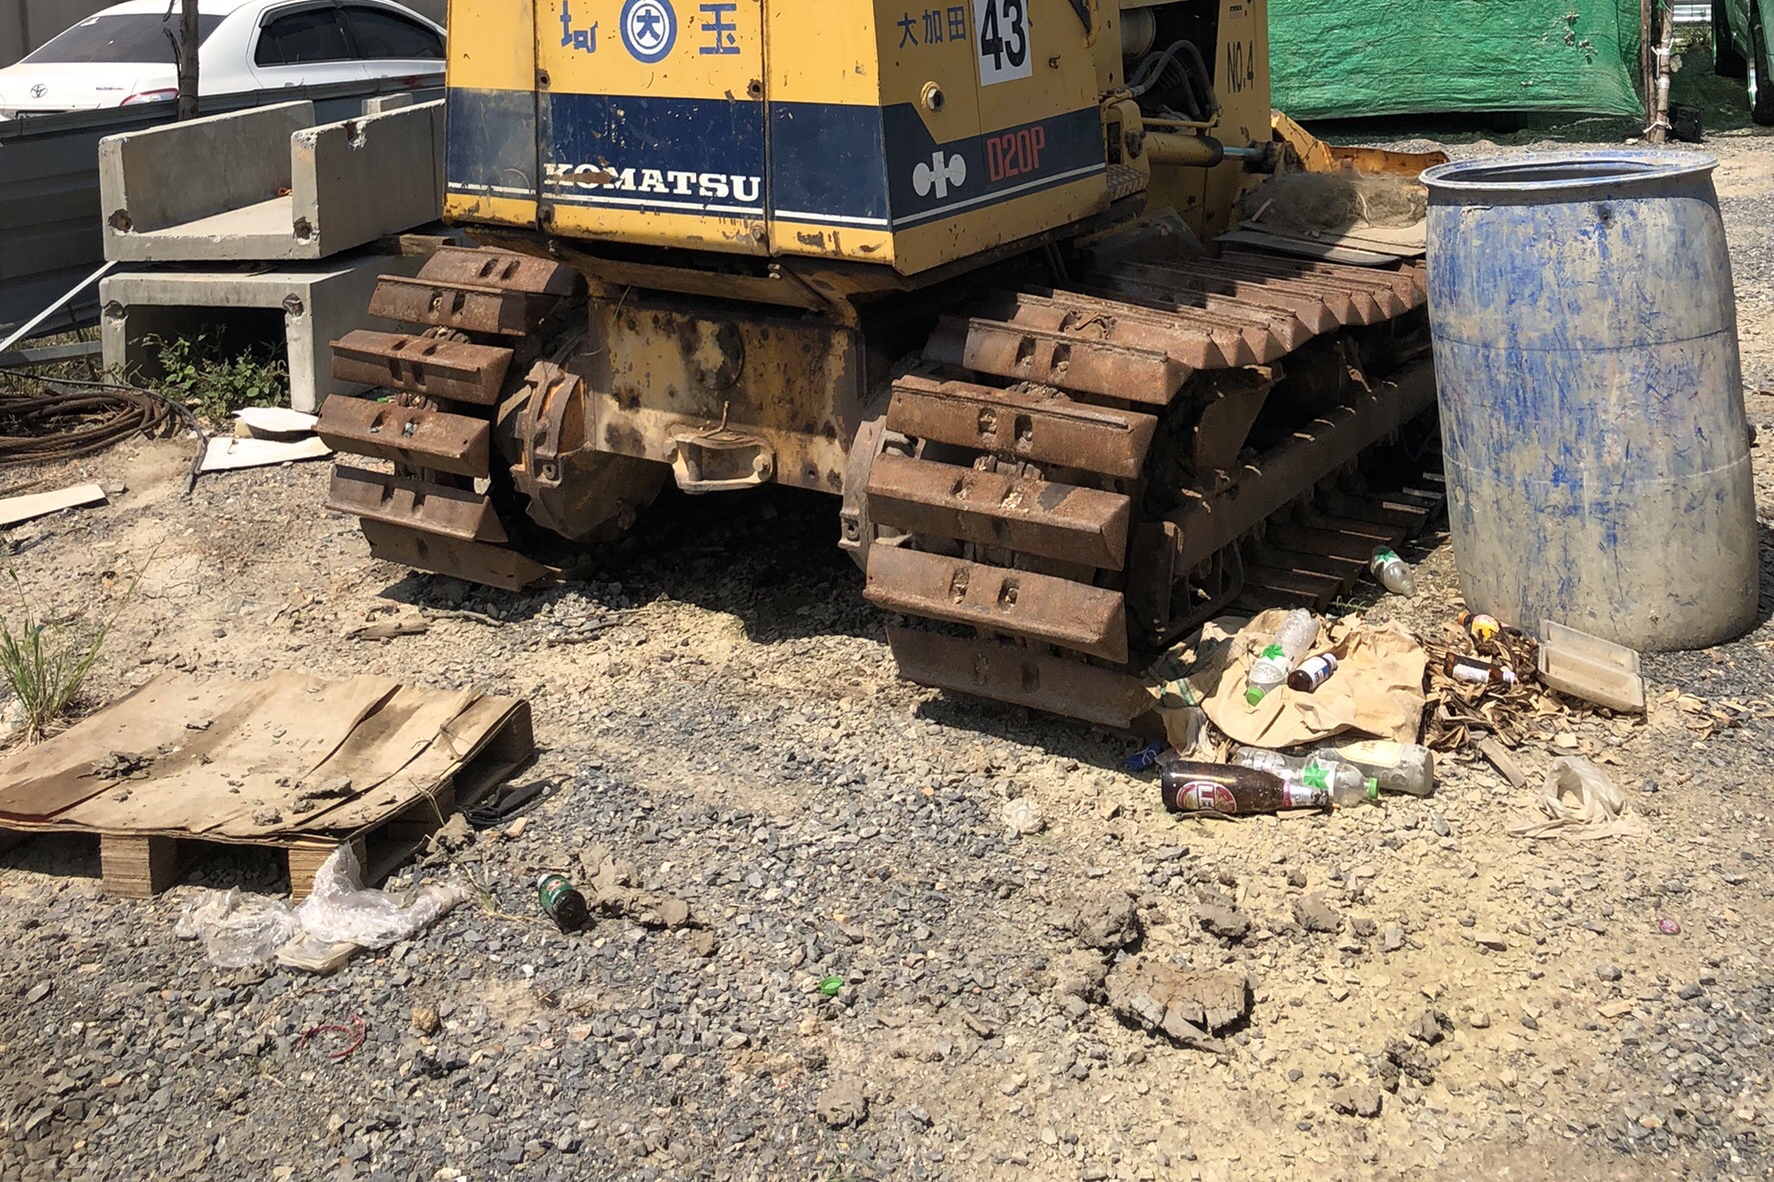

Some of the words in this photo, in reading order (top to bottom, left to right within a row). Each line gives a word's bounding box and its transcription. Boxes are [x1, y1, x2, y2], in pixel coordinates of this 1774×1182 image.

[637, 9, 660, 41] 大
[987, 125, 1046, 182] D20P
[544, 163, 761, 202] KOMATSU
